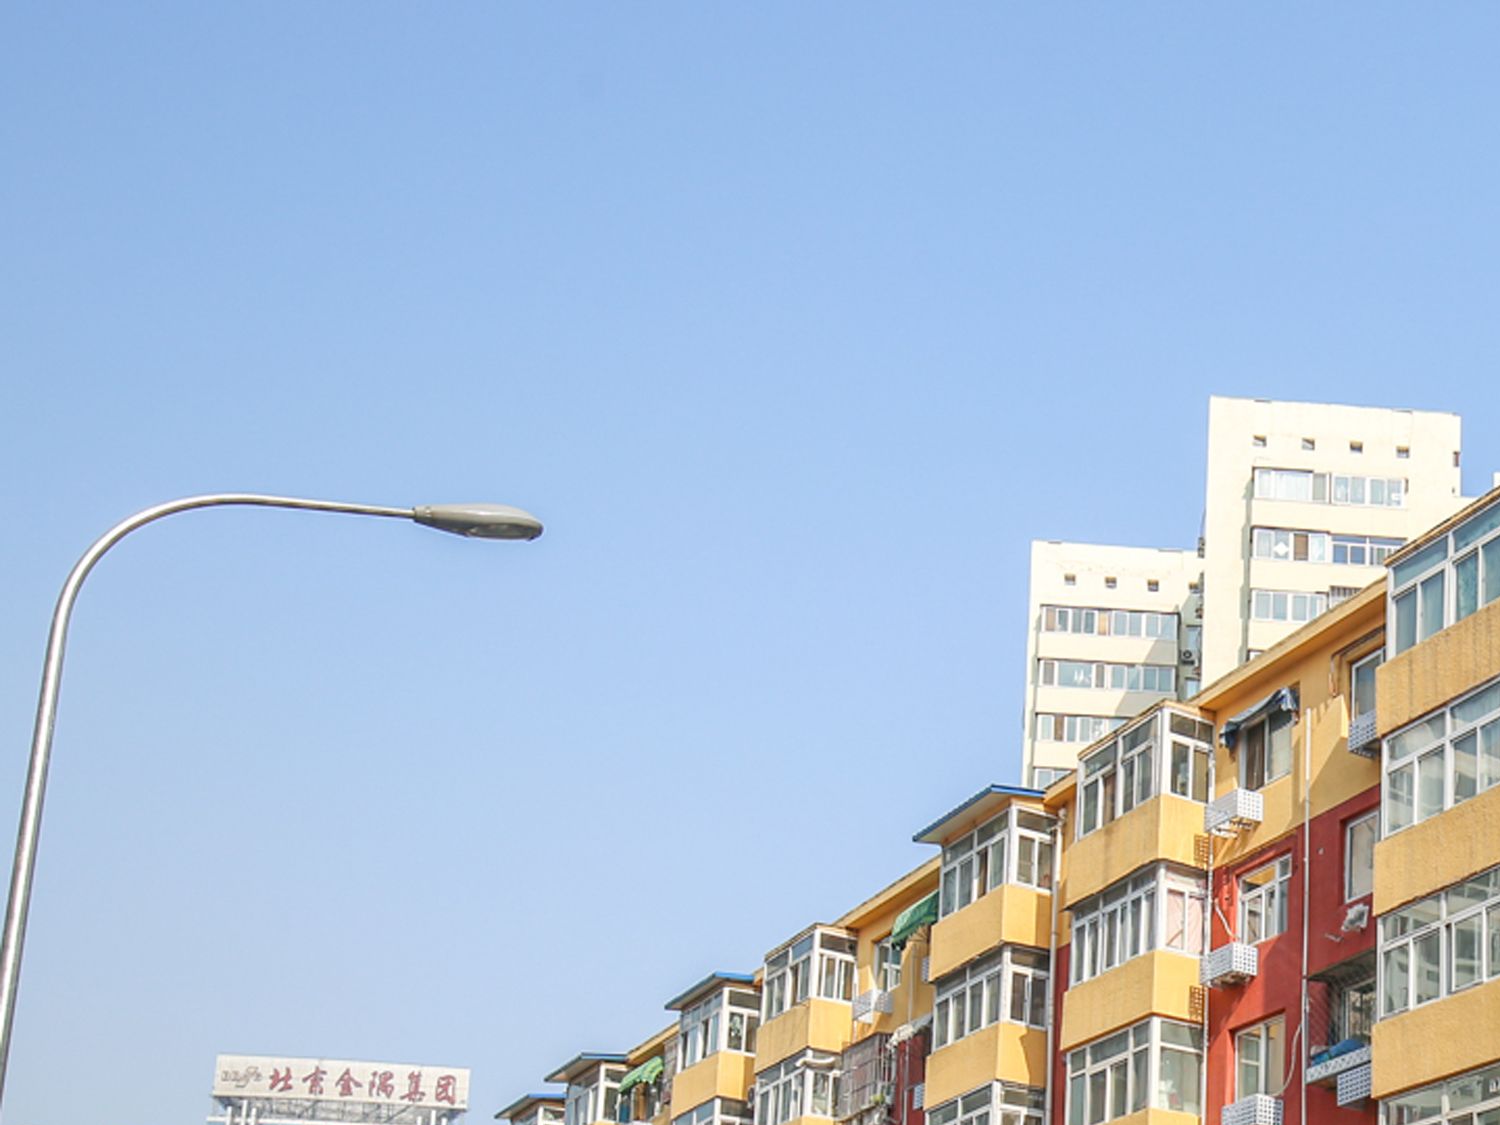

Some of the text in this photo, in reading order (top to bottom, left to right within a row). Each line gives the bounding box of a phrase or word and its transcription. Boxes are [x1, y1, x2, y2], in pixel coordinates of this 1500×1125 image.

[269, 1066, 457, 1105] 北京金隅集团
